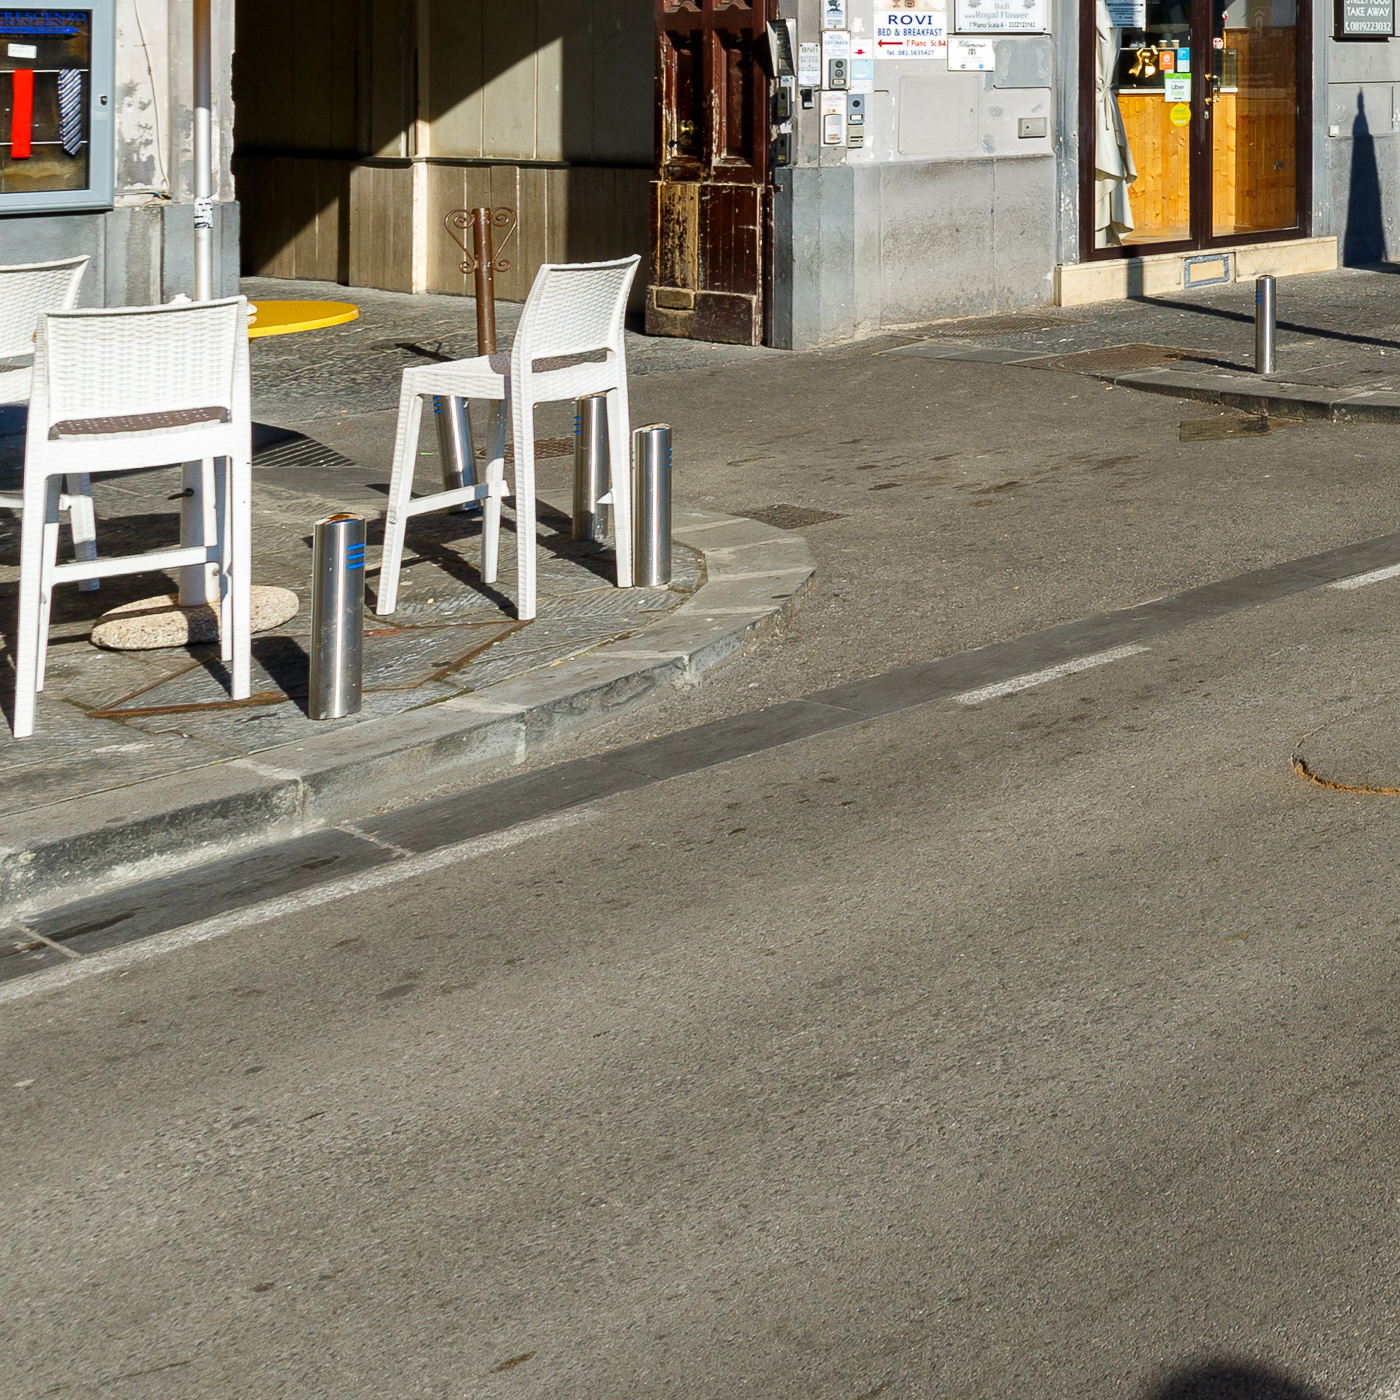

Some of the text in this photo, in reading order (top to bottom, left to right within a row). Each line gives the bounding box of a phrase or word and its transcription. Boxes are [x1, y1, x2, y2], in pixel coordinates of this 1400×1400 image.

[975, 10, 1029, 19] Royal Flower
[1346, 7, 1390, 17] TAKE AWAY
[888, 14, 933, 26] ROVI
[1350, 21, 1392, 31] 0819223032
[877, 28, 892, 37] BED
[903, 28, 943, 37] BREAKFAST
